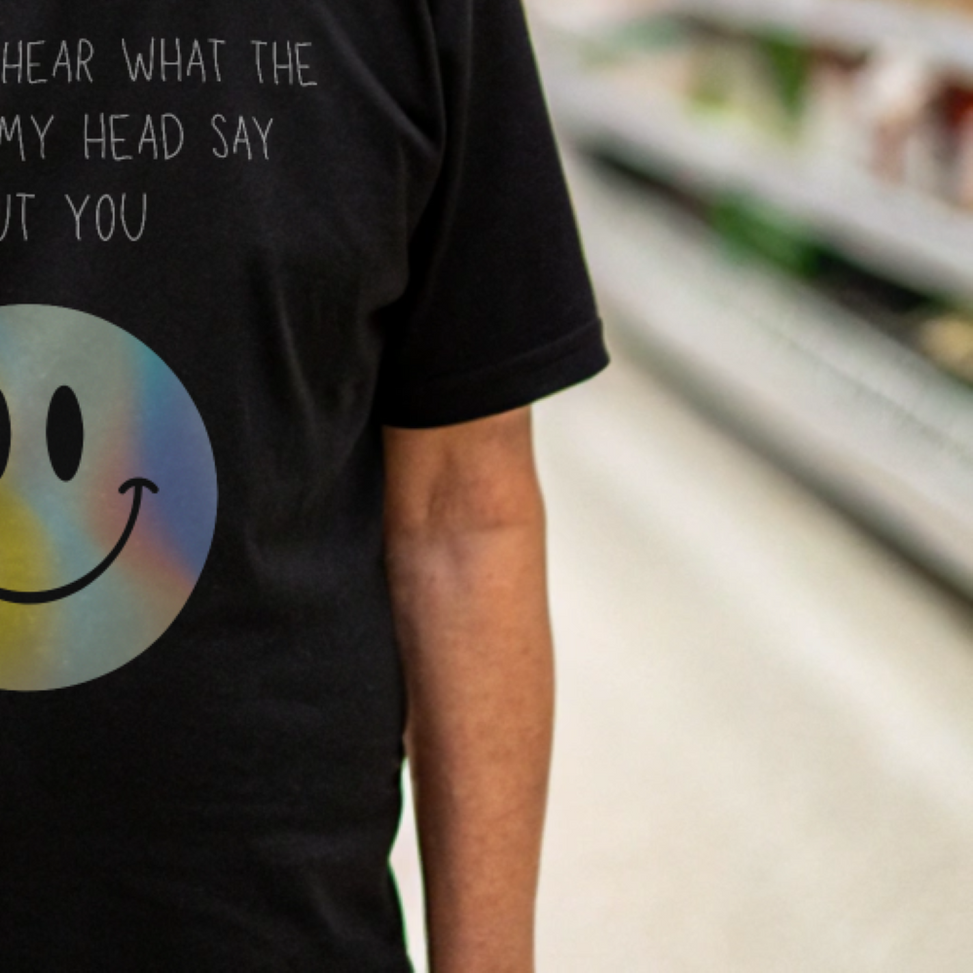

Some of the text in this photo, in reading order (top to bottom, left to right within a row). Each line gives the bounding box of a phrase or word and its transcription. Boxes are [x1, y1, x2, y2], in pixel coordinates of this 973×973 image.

[2, 38, 94, 84] HEAR
[122, 37, 225, 83] WHAT
[251, 40, 318, 86] THE
[84, 113, 184, 160] HEAD
[211, 114, 274, 160] SAY
[66, 193, 147, 241] YOU
